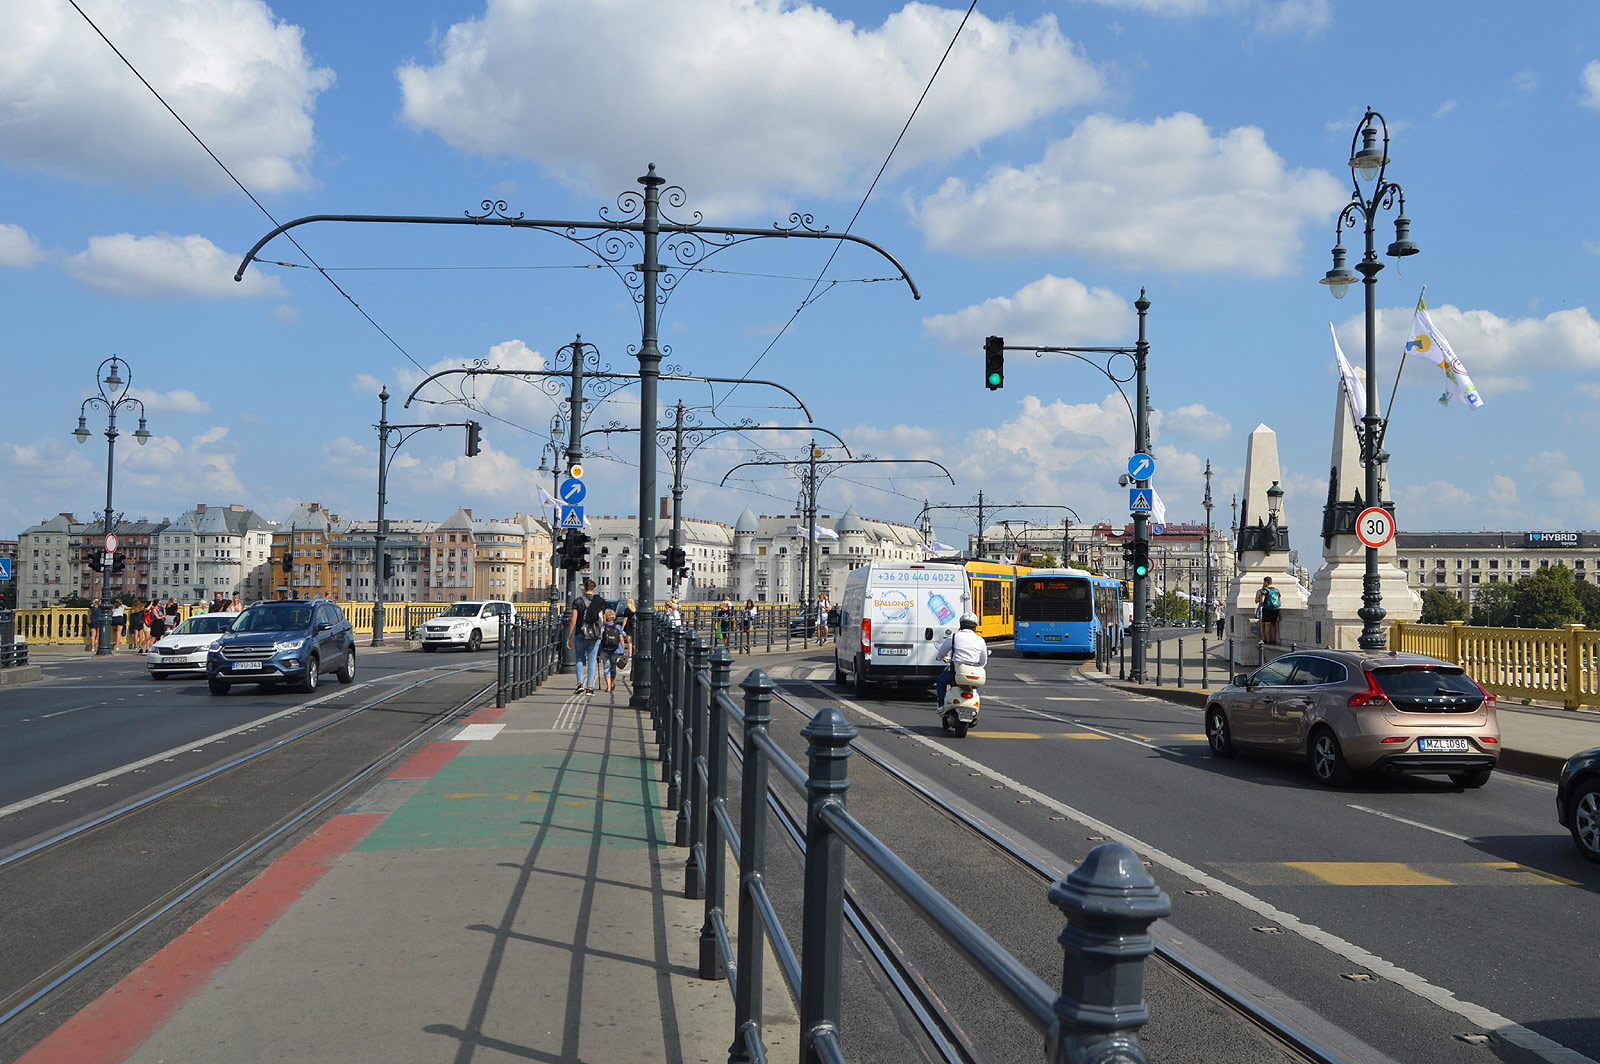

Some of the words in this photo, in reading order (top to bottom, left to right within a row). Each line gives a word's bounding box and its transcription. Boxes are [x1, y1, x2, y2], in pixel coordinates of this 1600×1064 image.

[1366, 519, 1385, 536] 30
[1529, 533, 1533, 541] I
[1541, 533, 1578, 541] HYBRID
[878, 572, 896, 580] +36
[898, 572, 910, 581] 20
[912, 573, 930, 581] 440
[932, 573, 955, 582] 4022
[874, 600, 914, 608] BALLONOS
